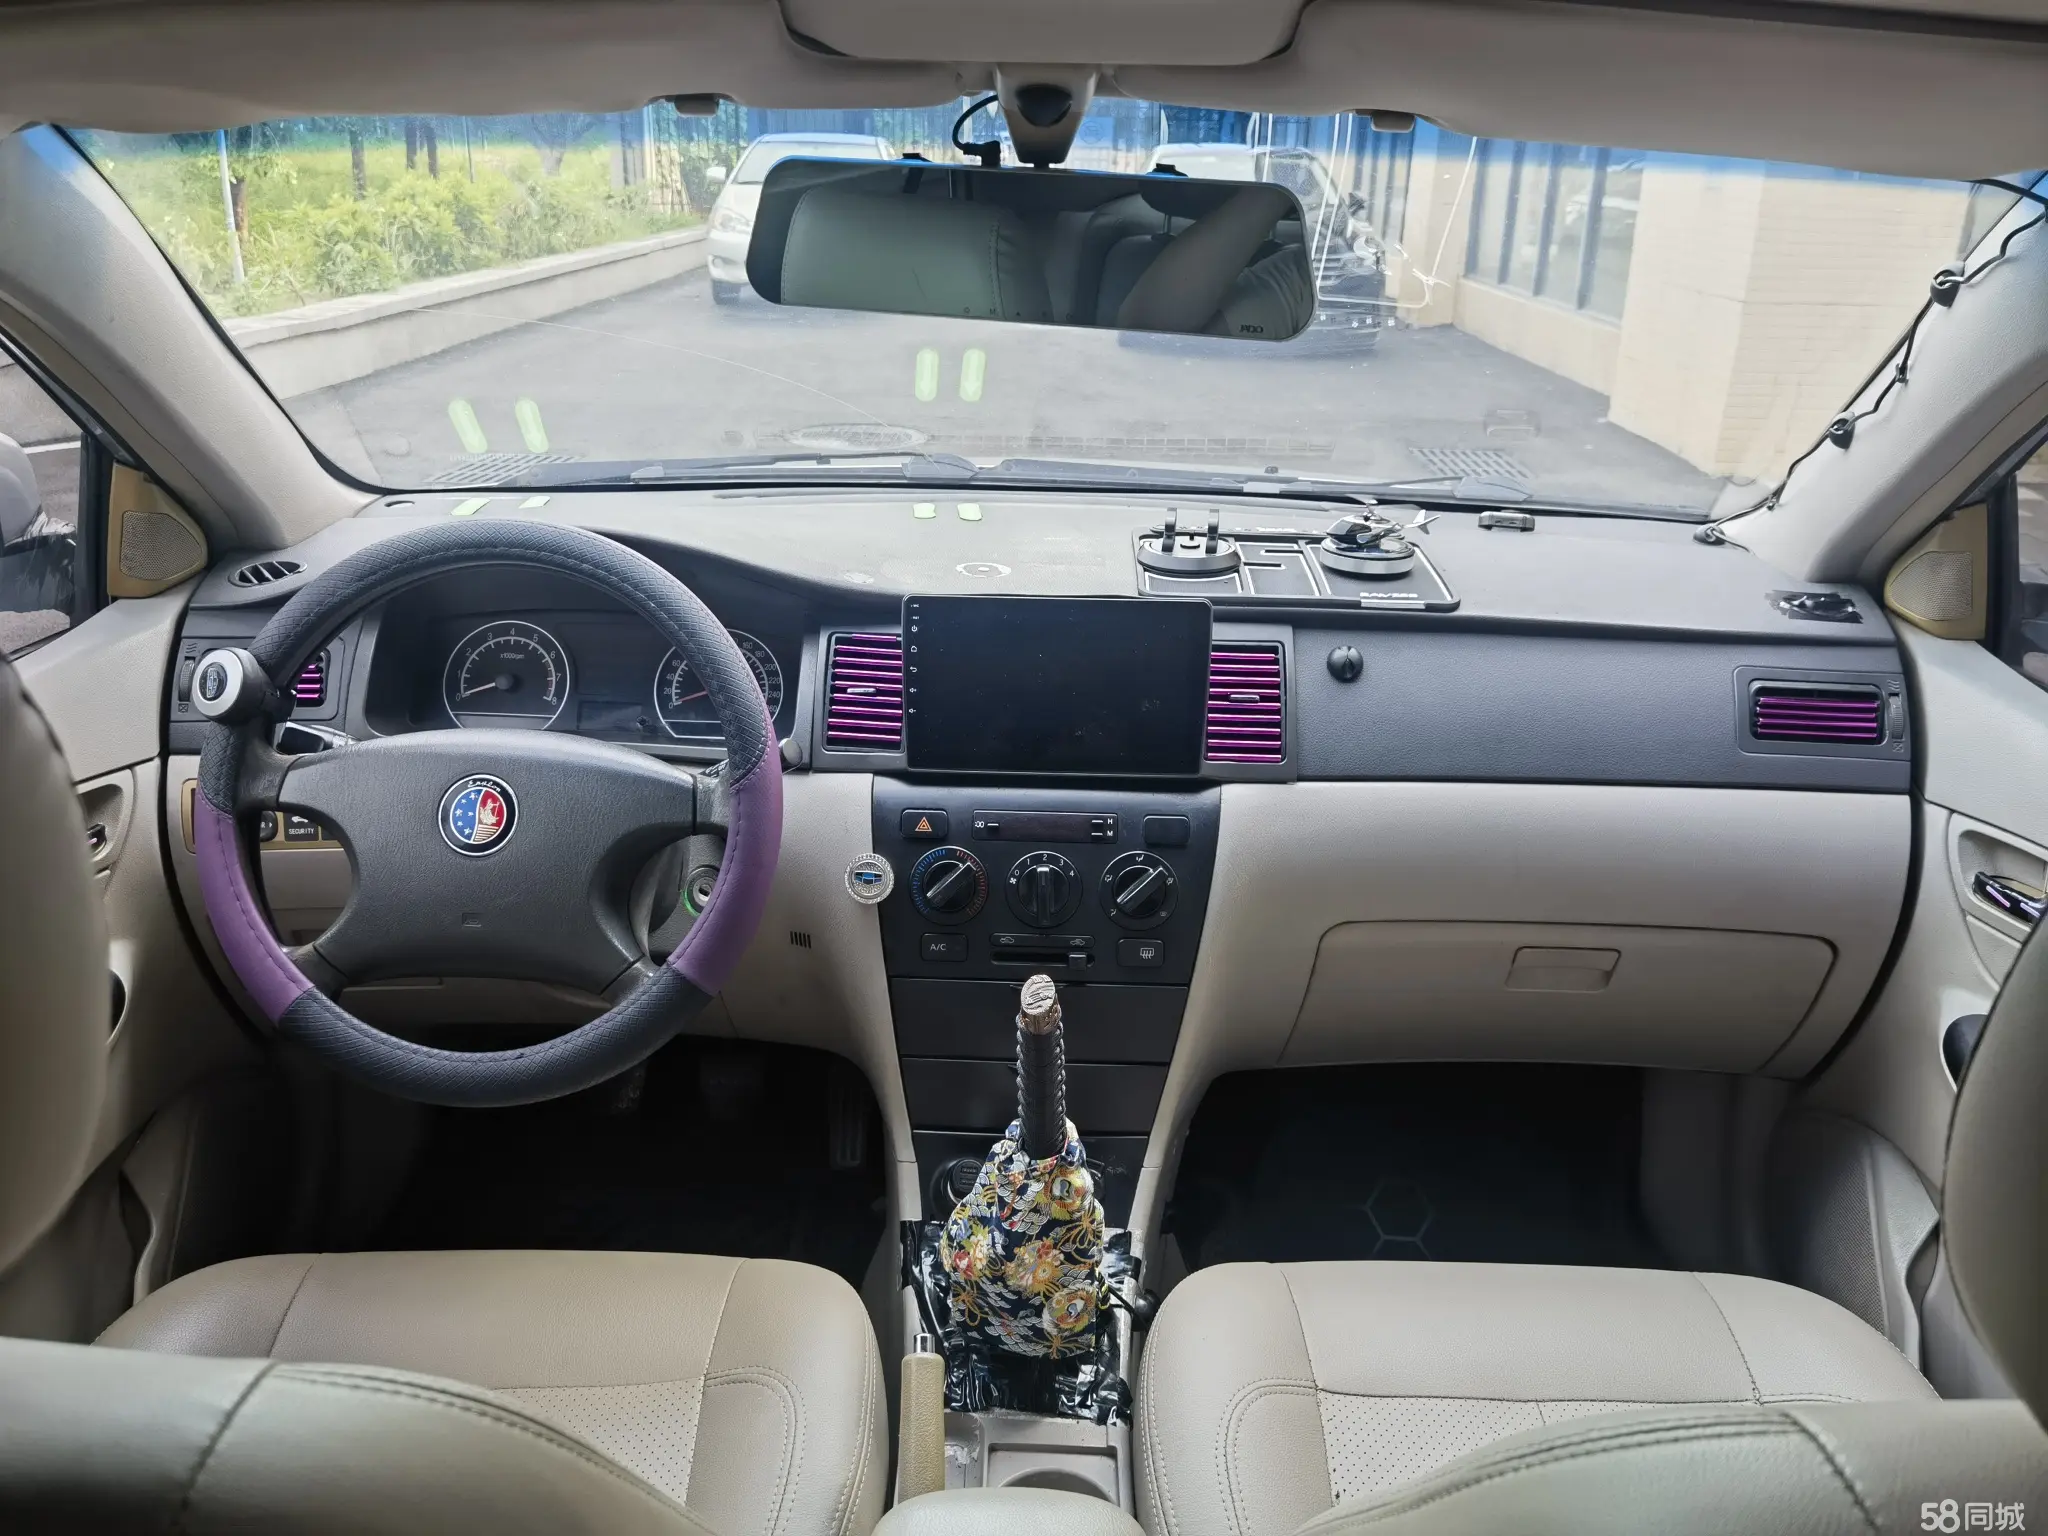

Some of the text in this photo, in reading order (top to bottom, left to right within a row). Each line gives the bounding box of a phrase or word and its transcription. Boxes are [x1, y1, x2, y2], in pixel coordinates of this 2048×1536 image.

[510, 627, 516, 636] 4
[487, 632, 493, 641] 3
[533, 634, 539, 642] 5
[465, 647, 472, 656] 2
[550, 650, 556, 659] 6
[671, 659, 681, 668] 60
[764, 663, 777, 671] 200
[556, 672, 562, 682] 7
[666, 673, 675, 681] 40
[455, 692, 461, 701] 0
[768, 690, 781, 698] 240
[551, 696, 557, 706] 8
[668, 702, 674, 710] 0
[288, 827, 315, 835] SECURITY
[1043, 853, 1048, 861] 2
[1059, 858, 1064, 866] 3
[1069, 869, 1075, 877] 4
[930, 943, 947, 951] A/C
